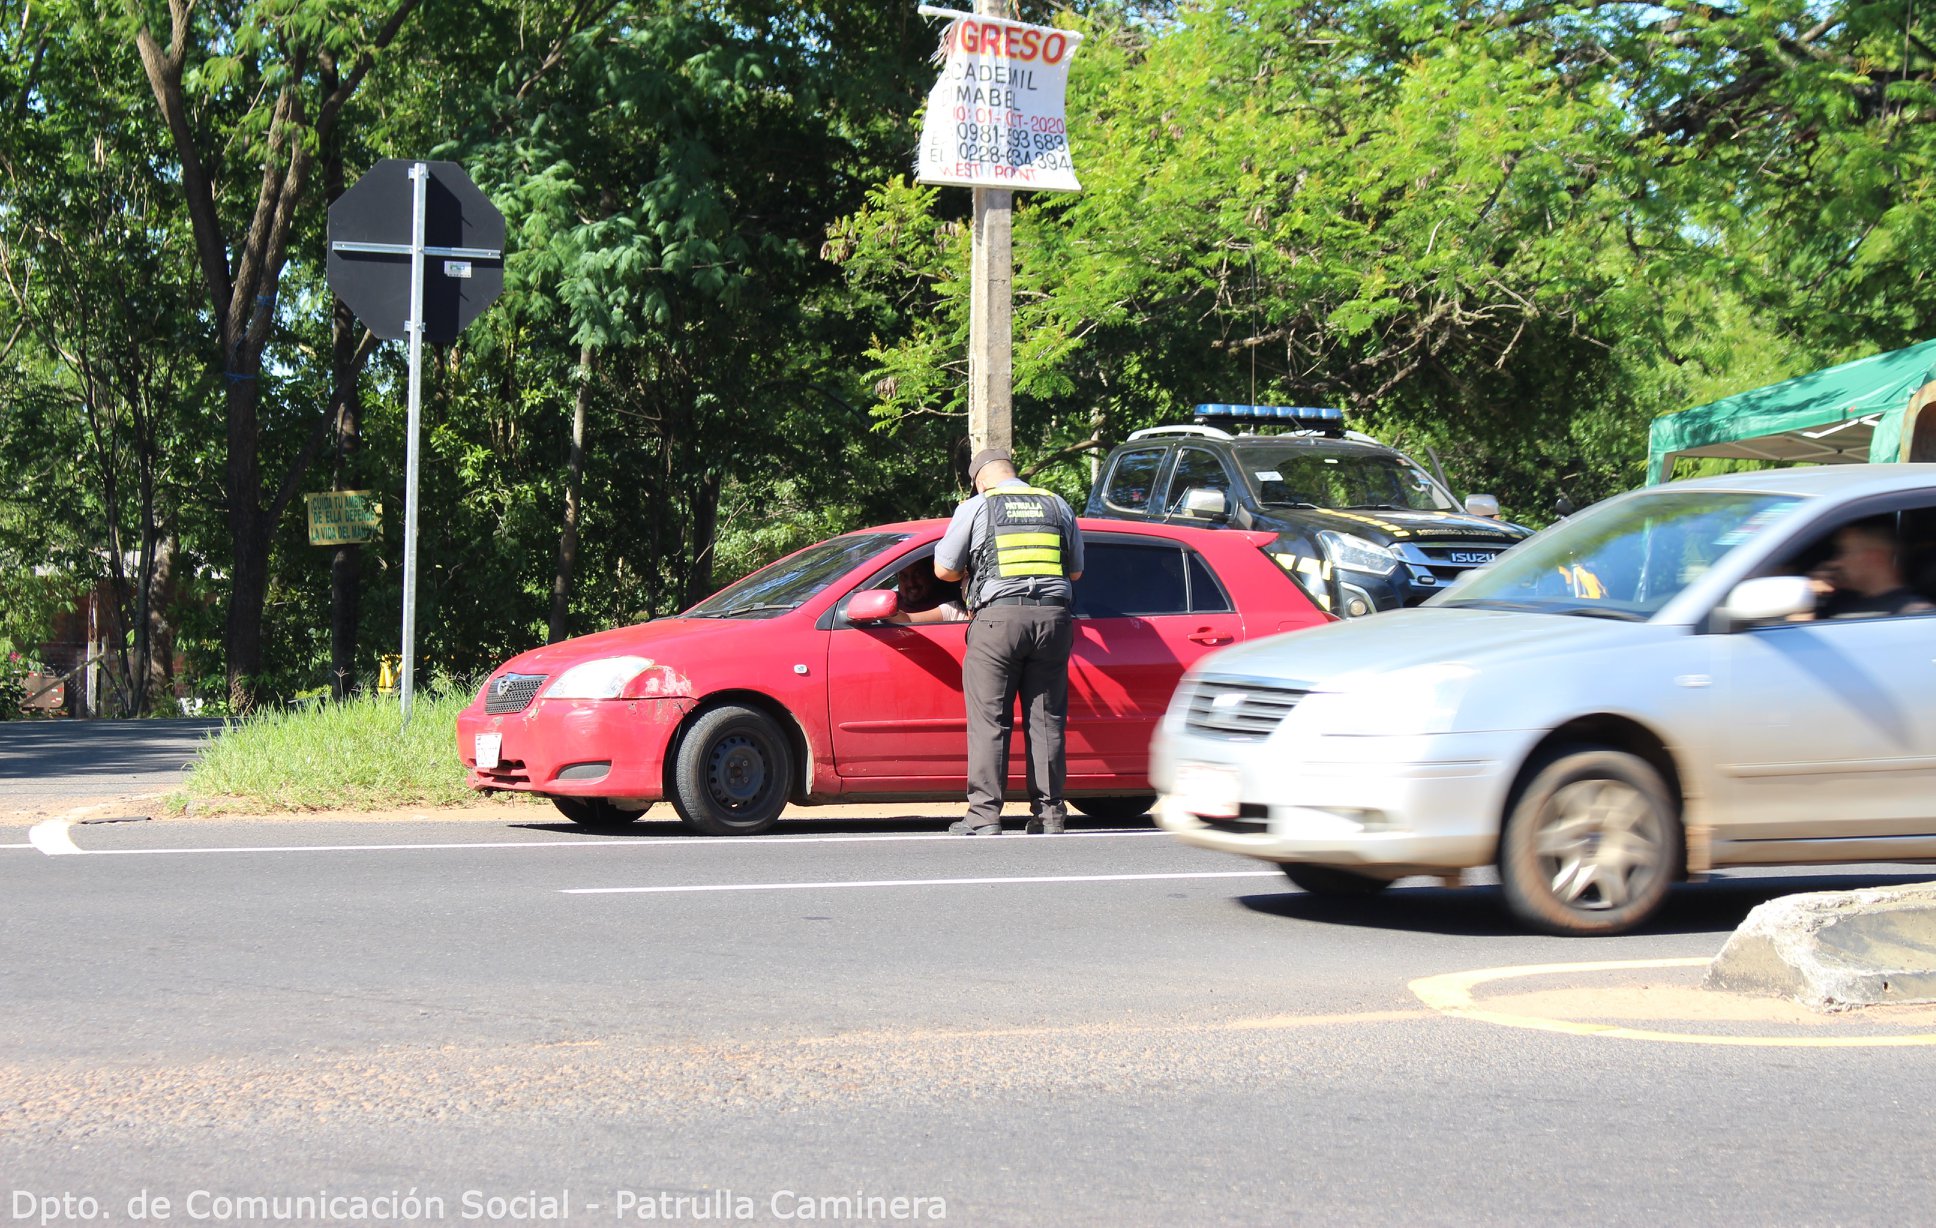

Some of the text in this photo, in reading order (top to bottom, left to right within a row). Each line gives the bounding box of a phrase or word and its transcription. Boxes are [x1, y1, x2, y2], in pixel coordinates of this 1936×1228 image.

[947, 86, 1021, 111] MABEL
[1033, 133, 1066, 153] 683
[1035, 151, 1072, 172] 394
[1005, 502, 1042, 510] PATRULLA
[1451, 552, 1496, 563] ISUZU
